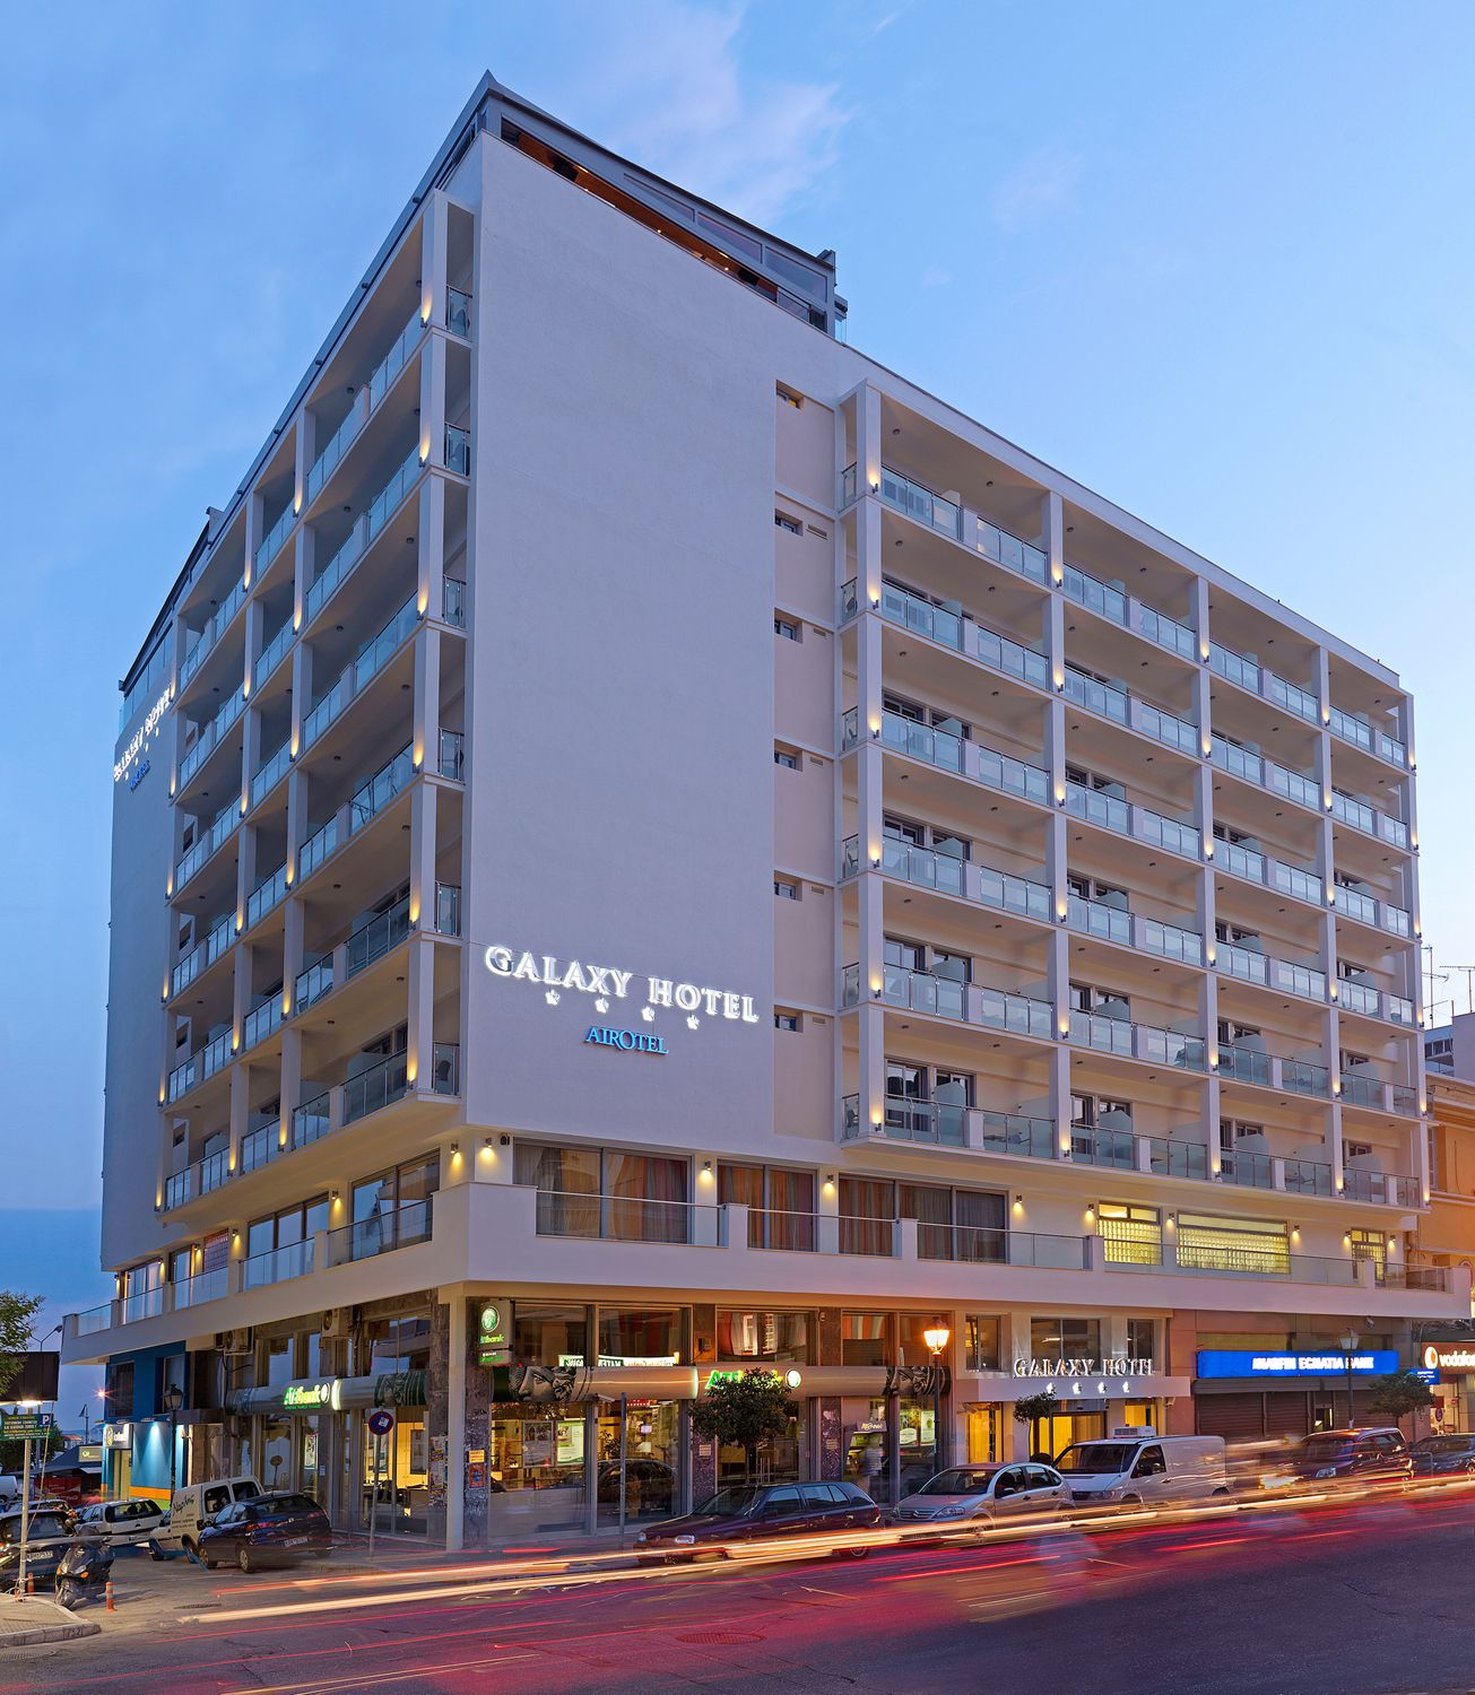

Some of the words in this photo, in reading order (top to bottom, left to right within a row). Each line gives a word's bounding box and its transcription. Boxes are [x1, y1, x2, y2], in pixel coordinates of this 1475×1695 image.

[485, 945, 633, 998] GALAXY
[647, 976, 760, 1023] HOTEL
[585, 1025, 669, 1055] AIROTEL
[1013, 1357, 1094, 1377] GALAXY
[42, 1415, 49, 1424] P
